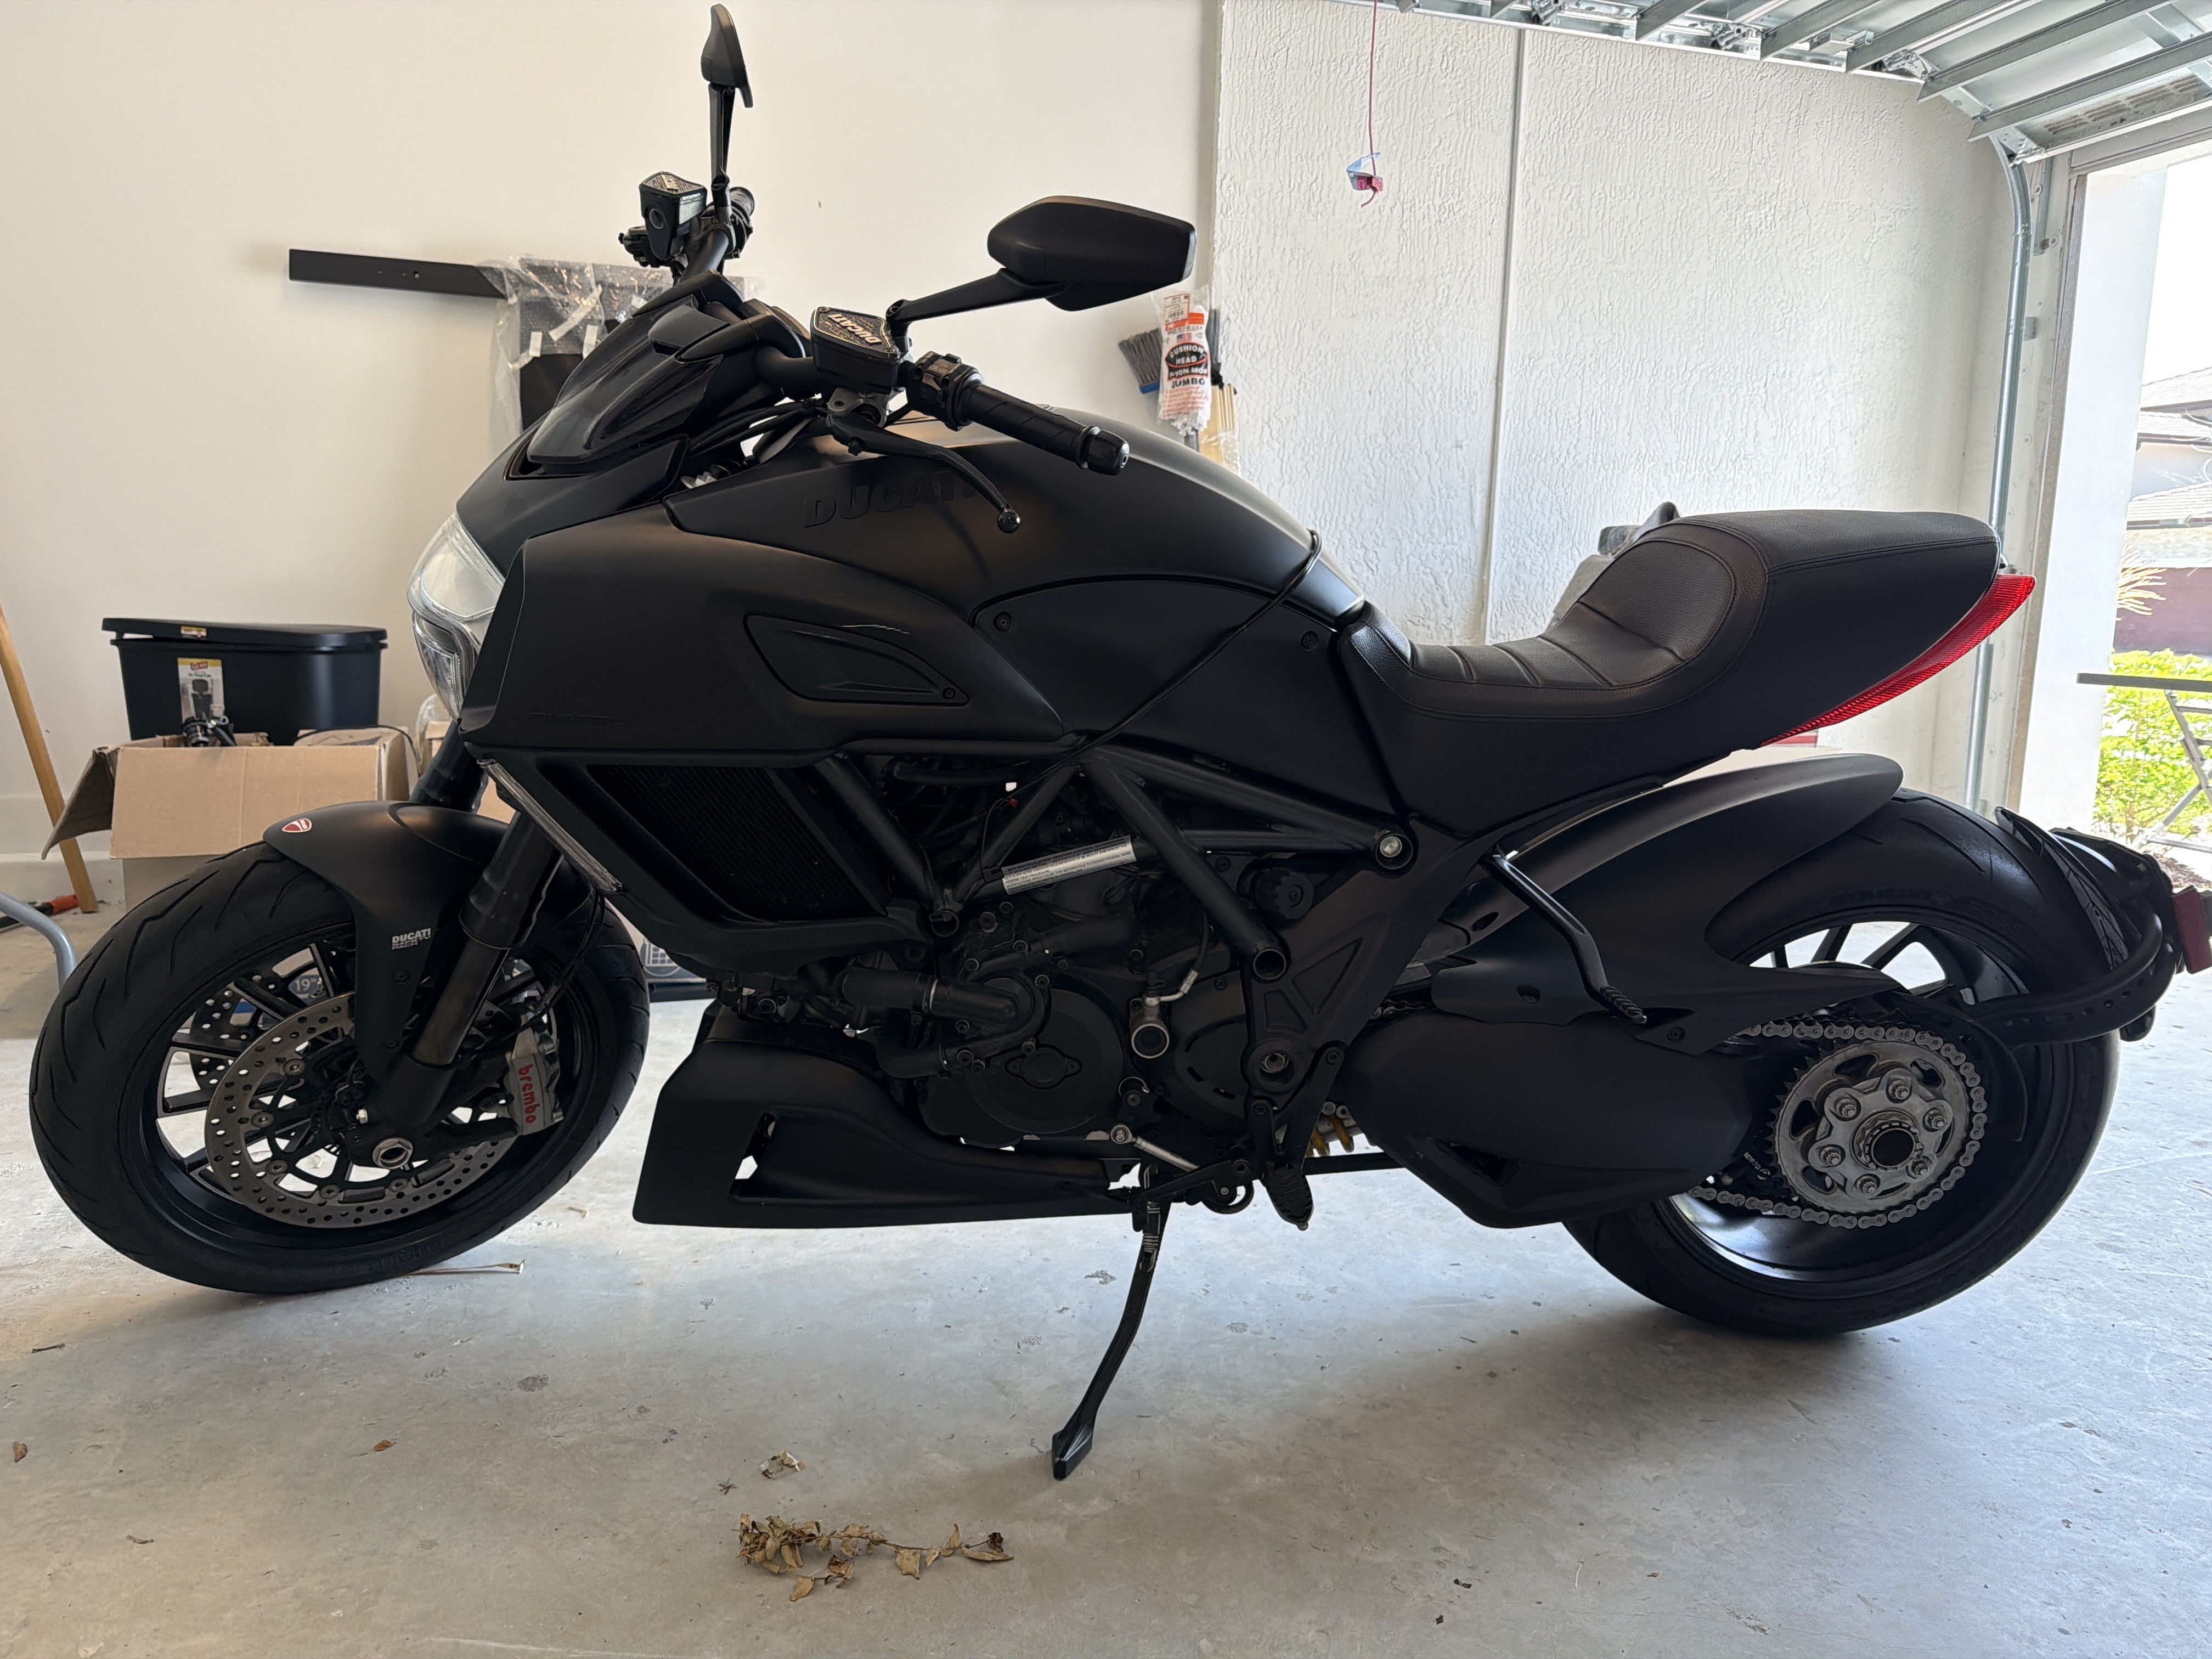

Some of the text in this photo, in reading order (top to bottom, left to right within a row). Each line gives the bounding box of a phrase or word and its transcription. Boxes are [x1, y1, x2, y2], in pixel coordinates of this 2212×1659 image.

[827, 313, 883, 344] DUCATI
[1170, 344, 1204, 358] CUSHION
[1176, 355, 1197, 365] HEAD
[1171, 377, 1205, 388] JUMBO
[392, 928, 431, 943] DUCATI
[518, 1064, 540, 1124] brembo
